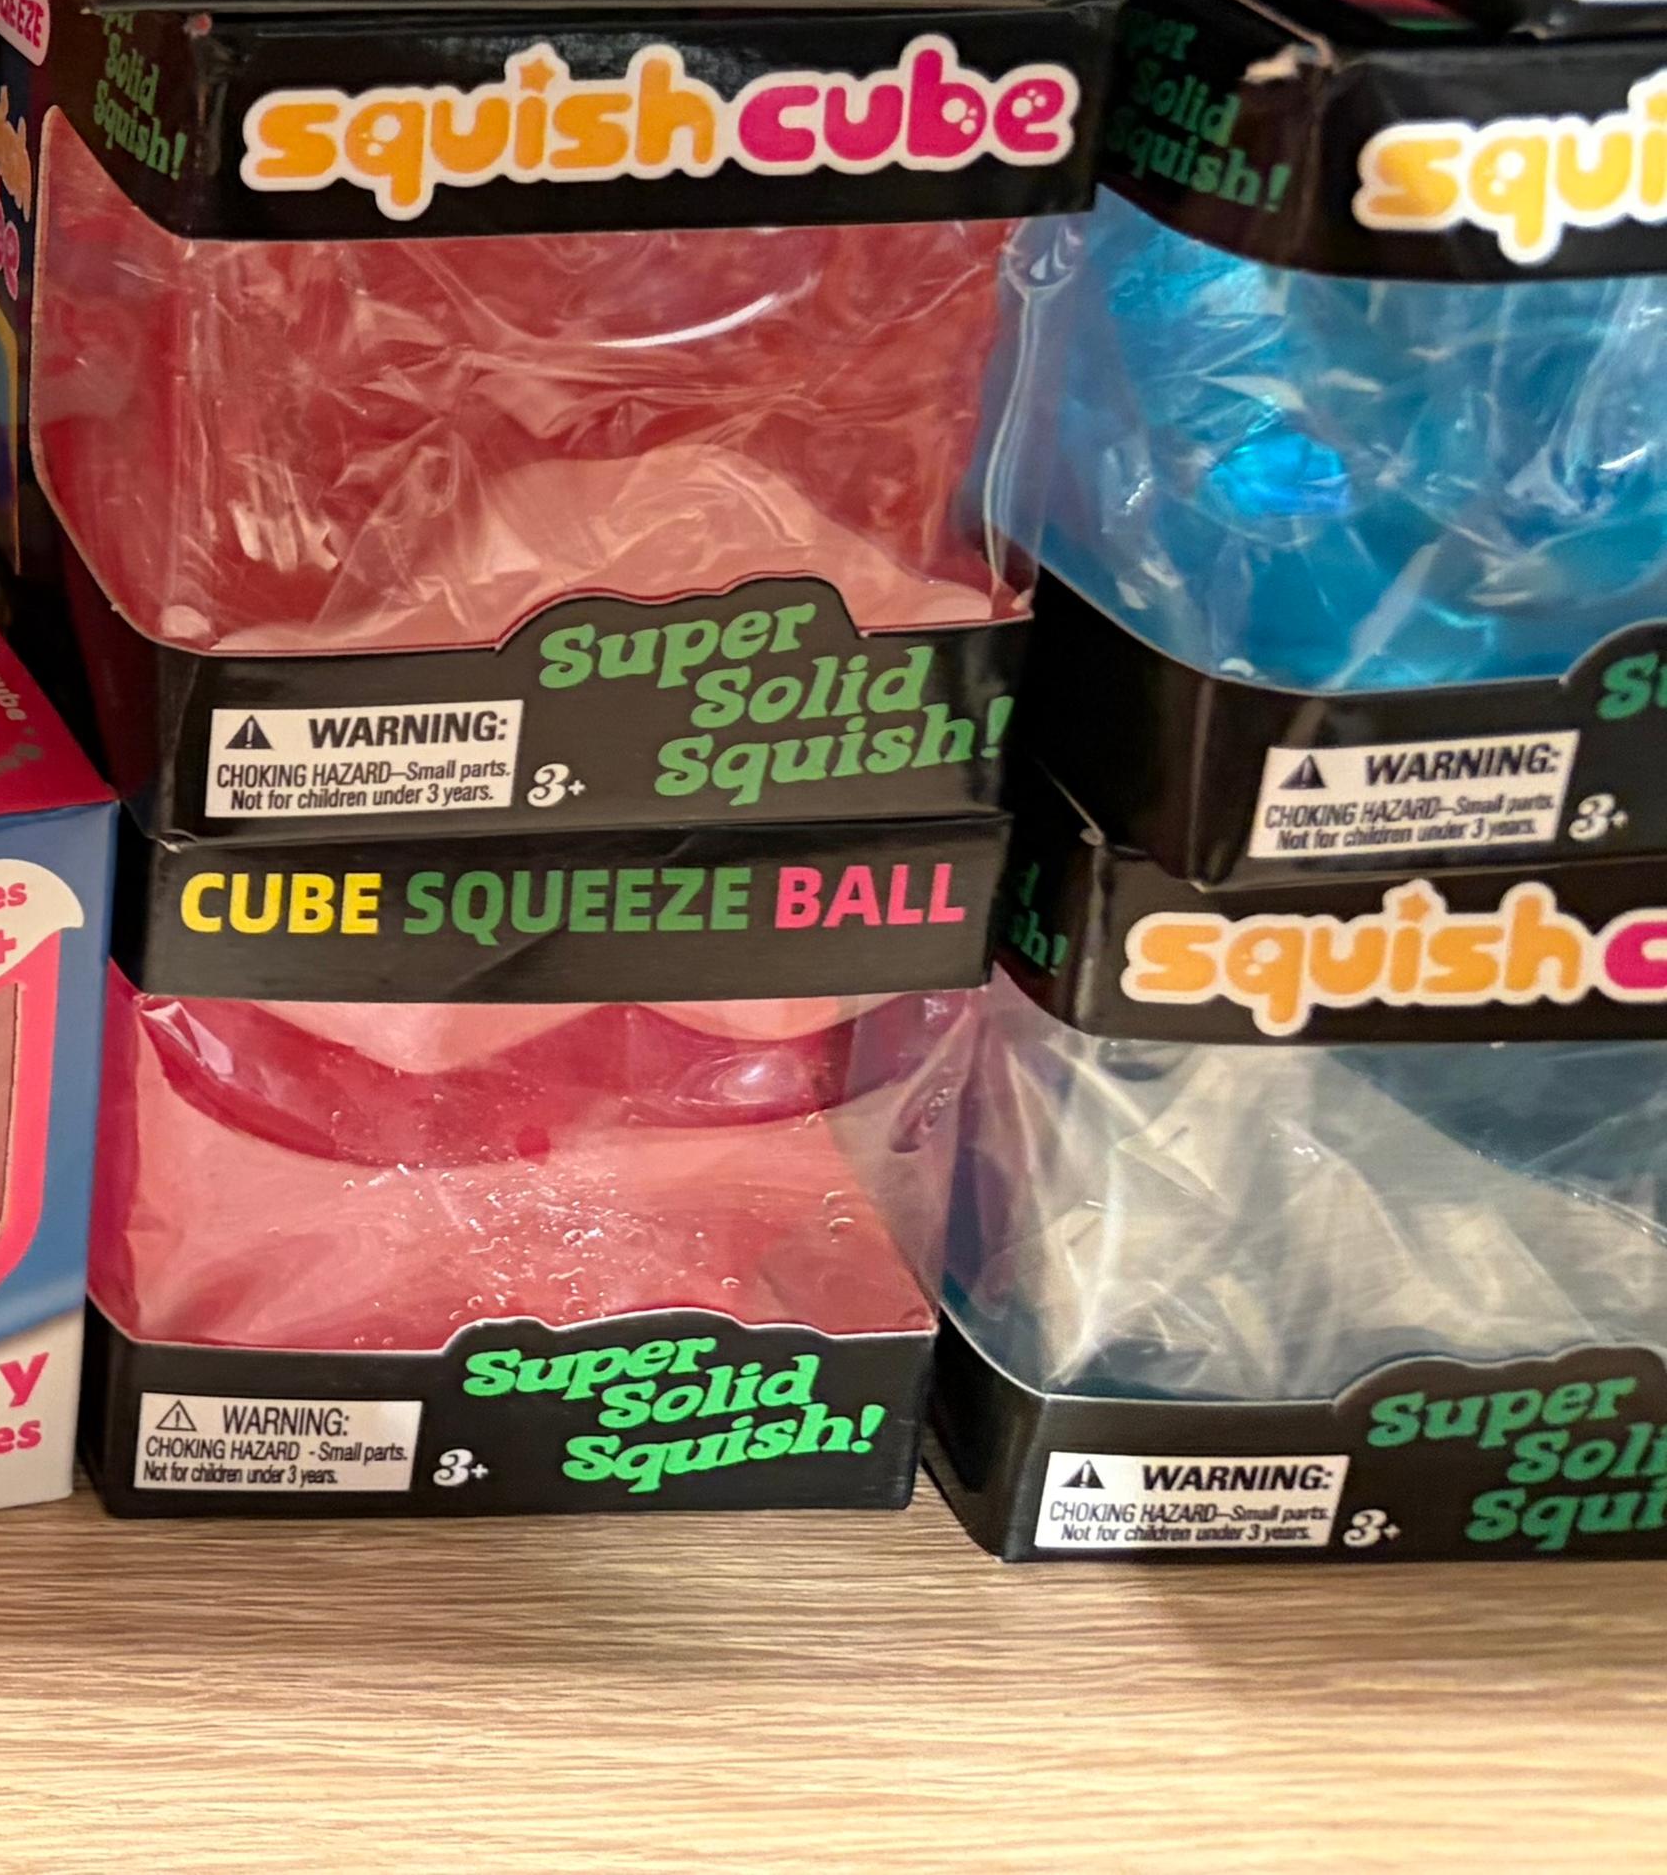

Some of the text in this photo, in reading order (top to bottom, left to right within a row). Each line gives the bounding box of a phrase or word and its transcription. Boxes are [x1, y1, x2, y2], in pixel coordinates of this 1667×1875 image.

[539, 604, 814, 692] Super
[692, 647, 935, 728] Solid
[308, 711, 507, 748] WARNING:
[655, 695, 1014, 806] Squish!
[217, 764, 306, 787] CHOKING
[461, 760, 510, 780] parts.
[231, 784, 494, 810] Not for children under 3 years.
[526, 762, 586, 808] 3+
[181, 863, 965, 948] CUBE SQUEEZE BALL
[463, 1338, 717, 1401] Super
[599, 1354, 819, 1428] Solid
[563, 1405, 885, 1492] Squish!
[1144, 1466, 1333, 1491] WARNING:
